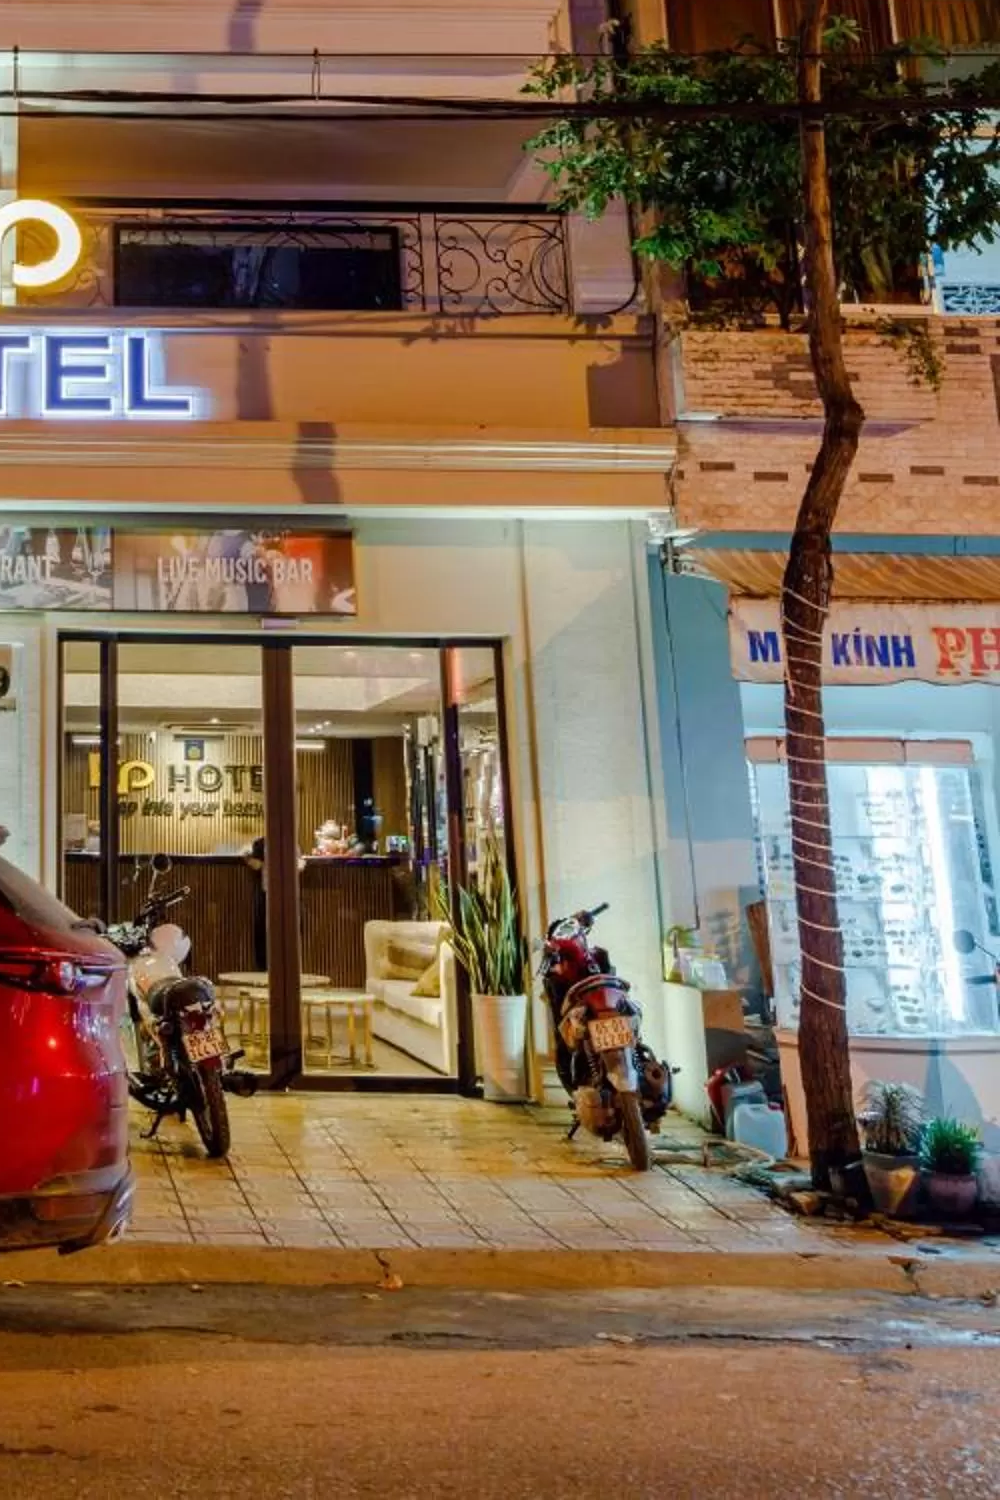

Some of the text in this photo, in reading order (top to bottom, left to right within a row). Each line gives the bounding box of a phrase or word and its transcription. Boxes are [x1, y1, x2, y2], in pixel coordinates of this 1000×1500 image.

[157, 556, 313, 583] LIVE MUSIC BAR
[831, 627, 917, 668] KÍNH
[167, 764, 264, 793] HOTE
